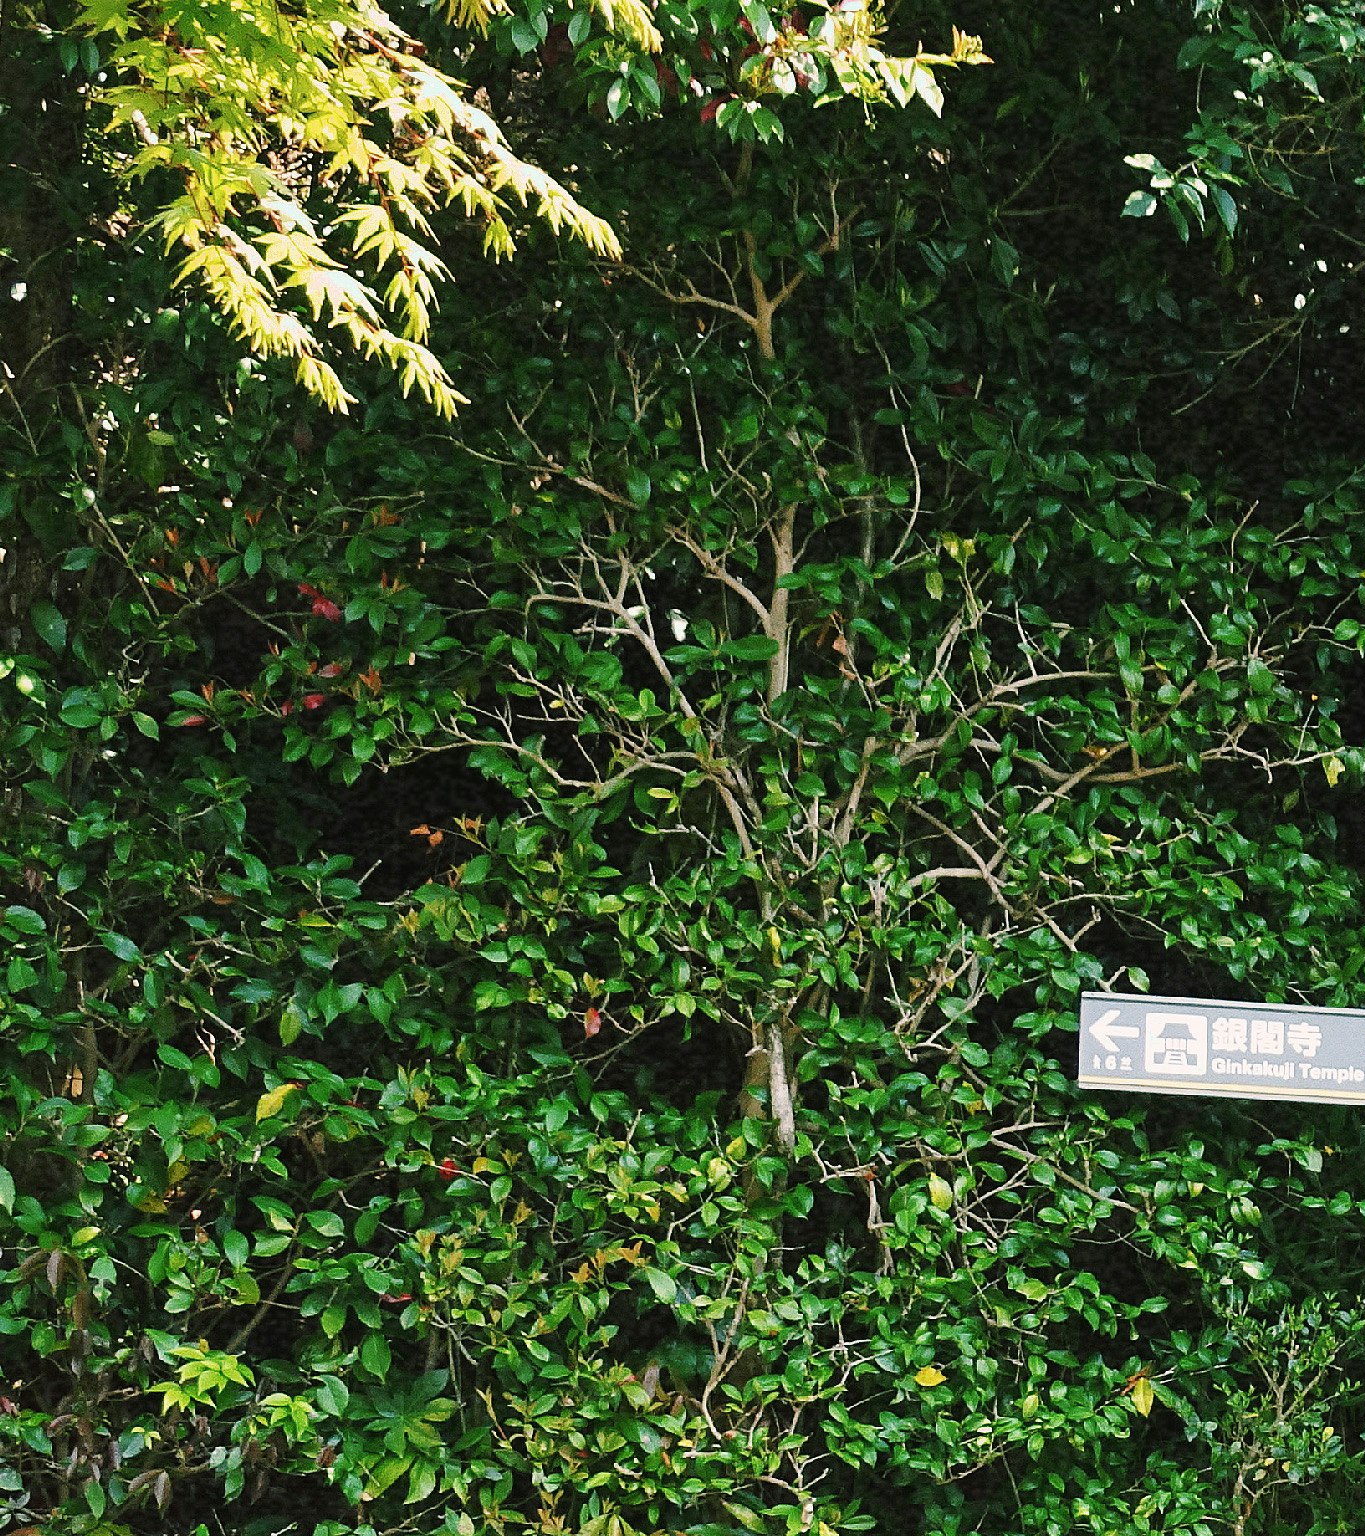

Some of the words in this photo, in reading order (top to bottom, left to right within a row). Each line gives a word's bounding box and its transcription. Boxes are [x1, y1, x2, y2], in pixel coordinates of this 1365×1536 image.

[1211, 1017, 1323, 1058] 銀閣寺
[1211, 1057, 1296, 1081] Ginkakuji
[1299, 1062, 1365, 1084] Temple
